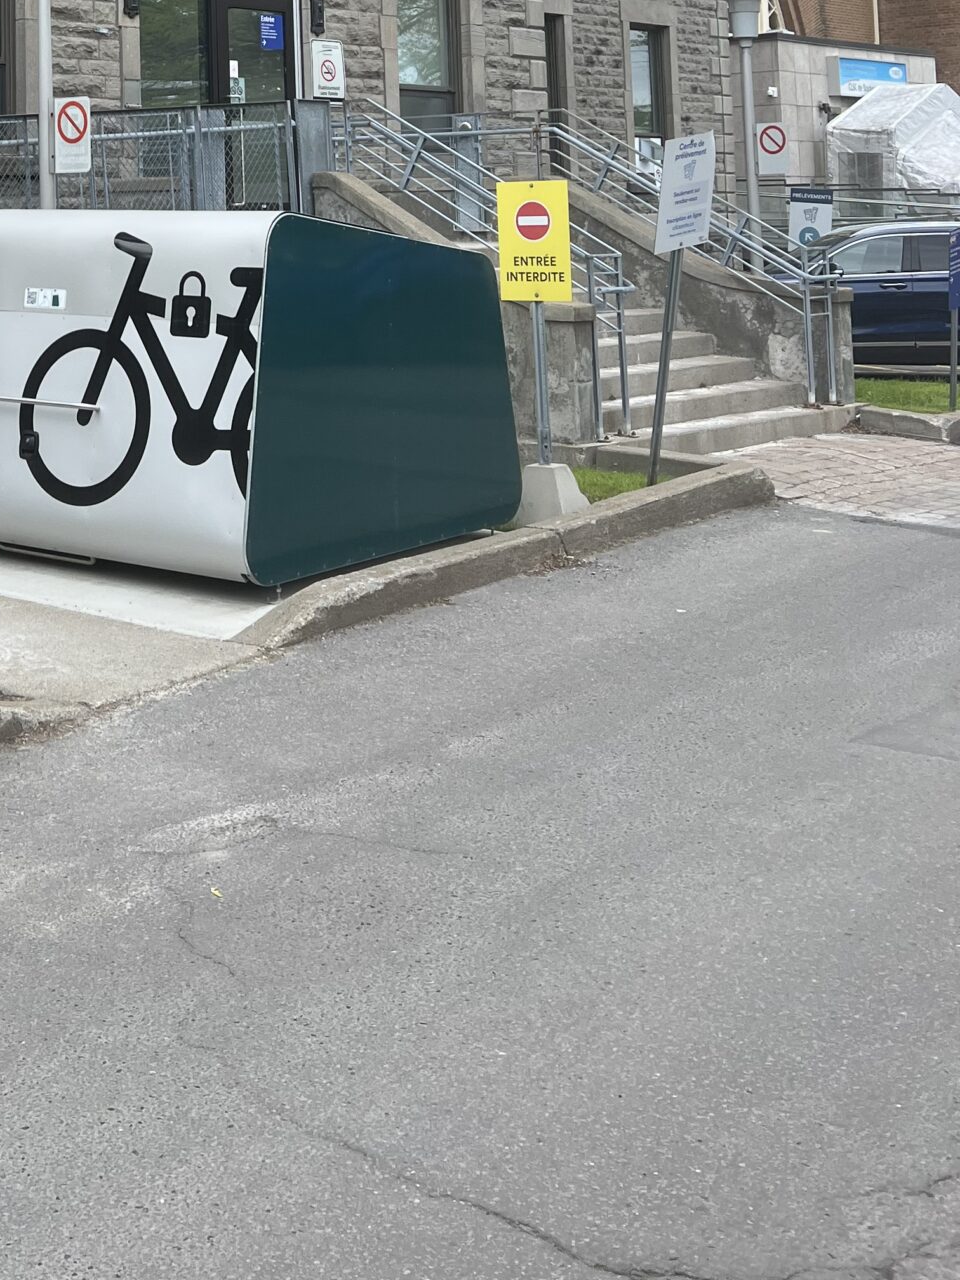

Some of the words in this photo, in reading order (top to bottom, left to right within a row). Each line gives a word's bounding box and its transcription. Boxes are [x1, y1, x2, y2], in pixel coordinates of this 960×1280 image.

[679, 140, 698, 150] Centre
[513, 254, 556, 266] ENTRÉE
[506, 271, 565, 282] INTERDITE
